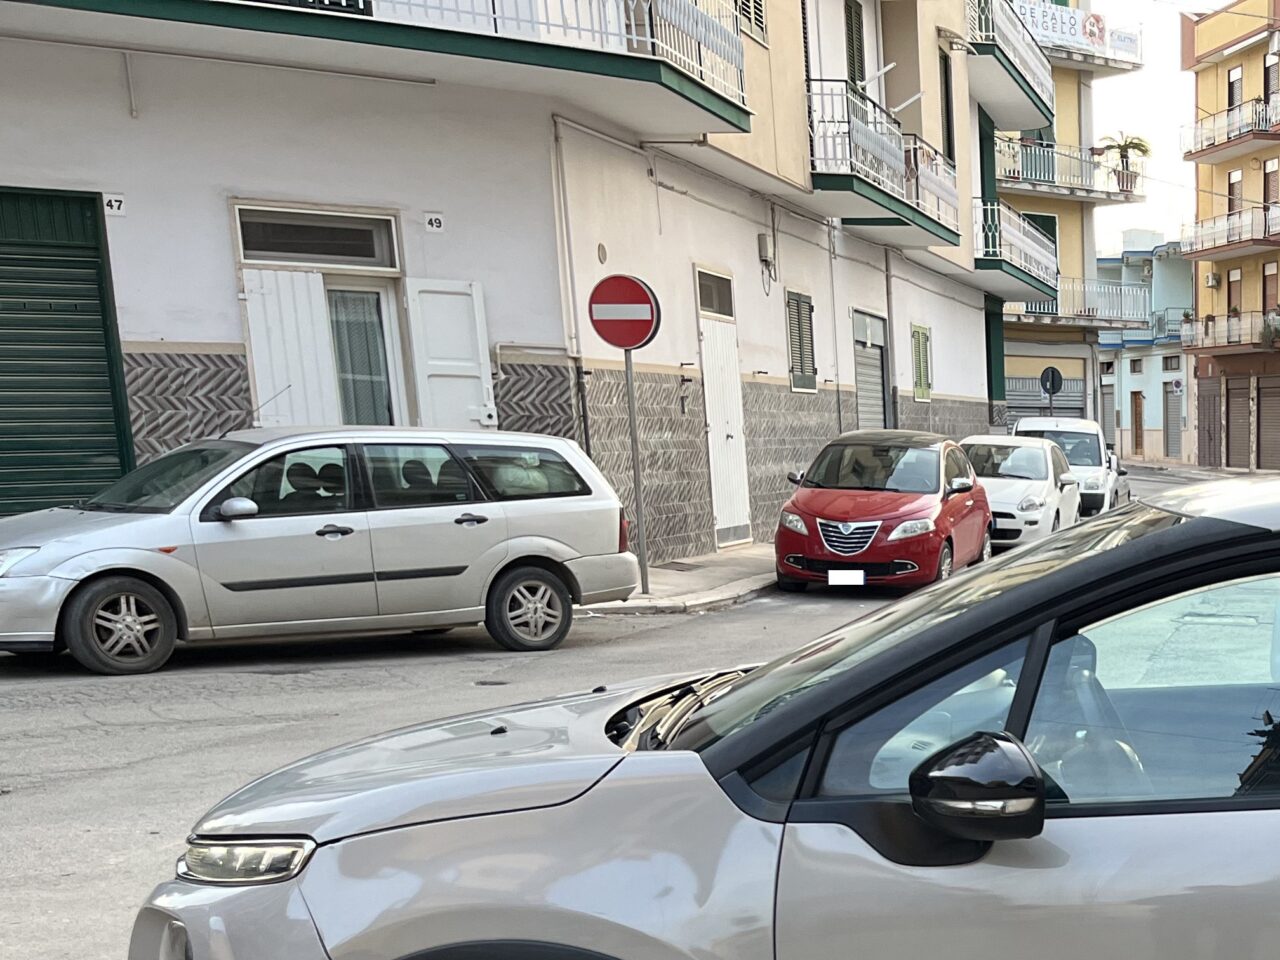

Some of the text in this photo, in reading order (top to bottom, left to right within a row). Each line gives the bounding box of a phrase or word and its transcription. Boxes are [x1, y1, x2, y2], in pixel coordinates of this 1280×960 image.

[1019, 5, 1077, 27] DE PALO
[1022, 16, 1077, 36] ANGELO
[106, 199, 123, 211] 47
[427, 217, 442, 229] 49
